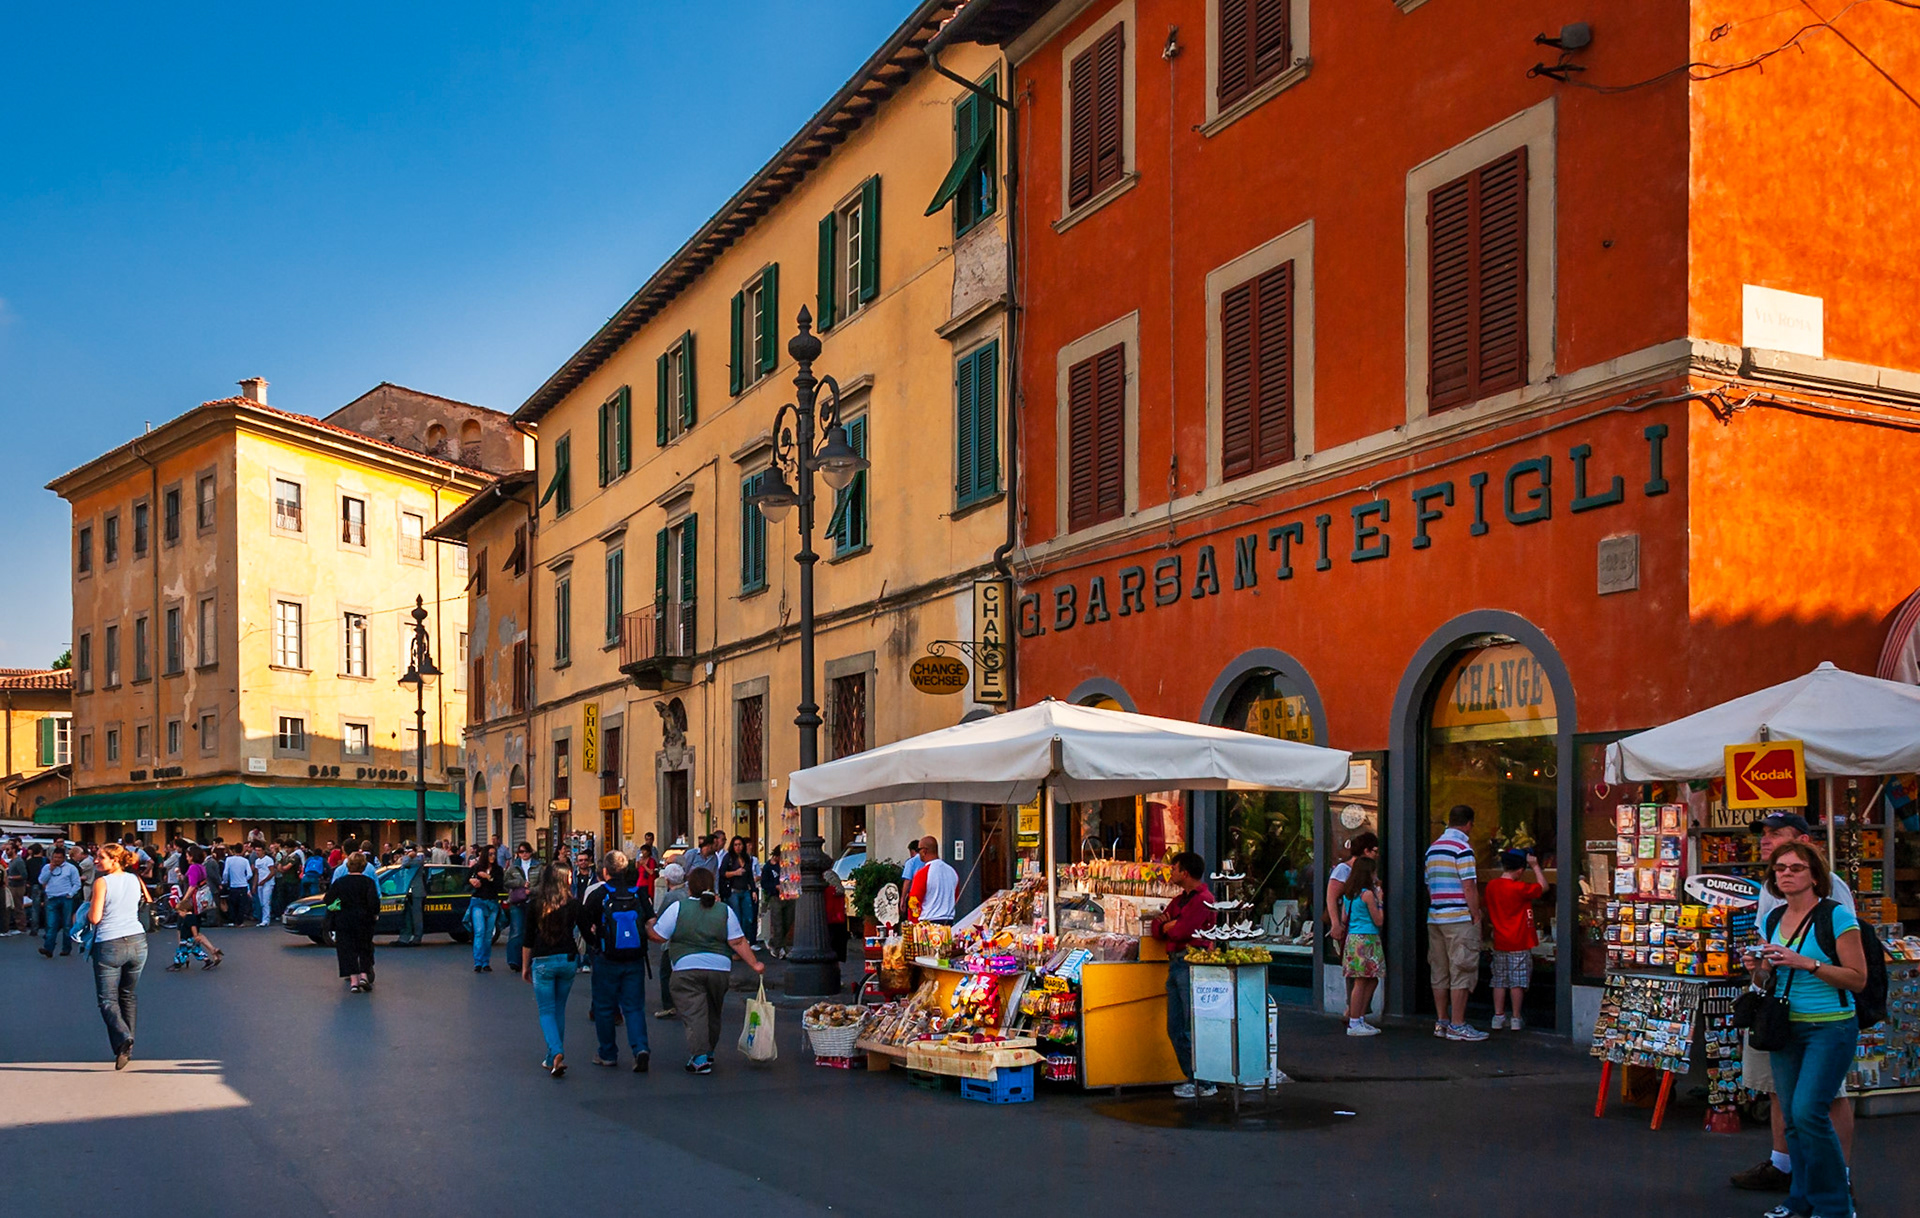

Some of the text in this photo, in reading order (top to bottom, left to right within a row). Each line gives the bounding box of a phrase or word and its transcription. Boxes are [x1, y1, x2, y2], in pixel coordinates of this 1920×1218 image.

[1755, 307, 1812, 332] VIA ROMA
[982, 586, 998, 686] CHANGE
[913, 663, 963, 675] CHANGE
[912, 675, 964, 686] WECHSEL
[1456, 657, 1543, 714] CHANGE
[585, 705, 595, 770] CHANGE
[308, 765, 408, 781] BAR DUOMO
[1751, 768, 1793, 781] Kodak
[1706, 878, 1754, 895] DURACELL
[424, 903, 453, 912] FINANZA
